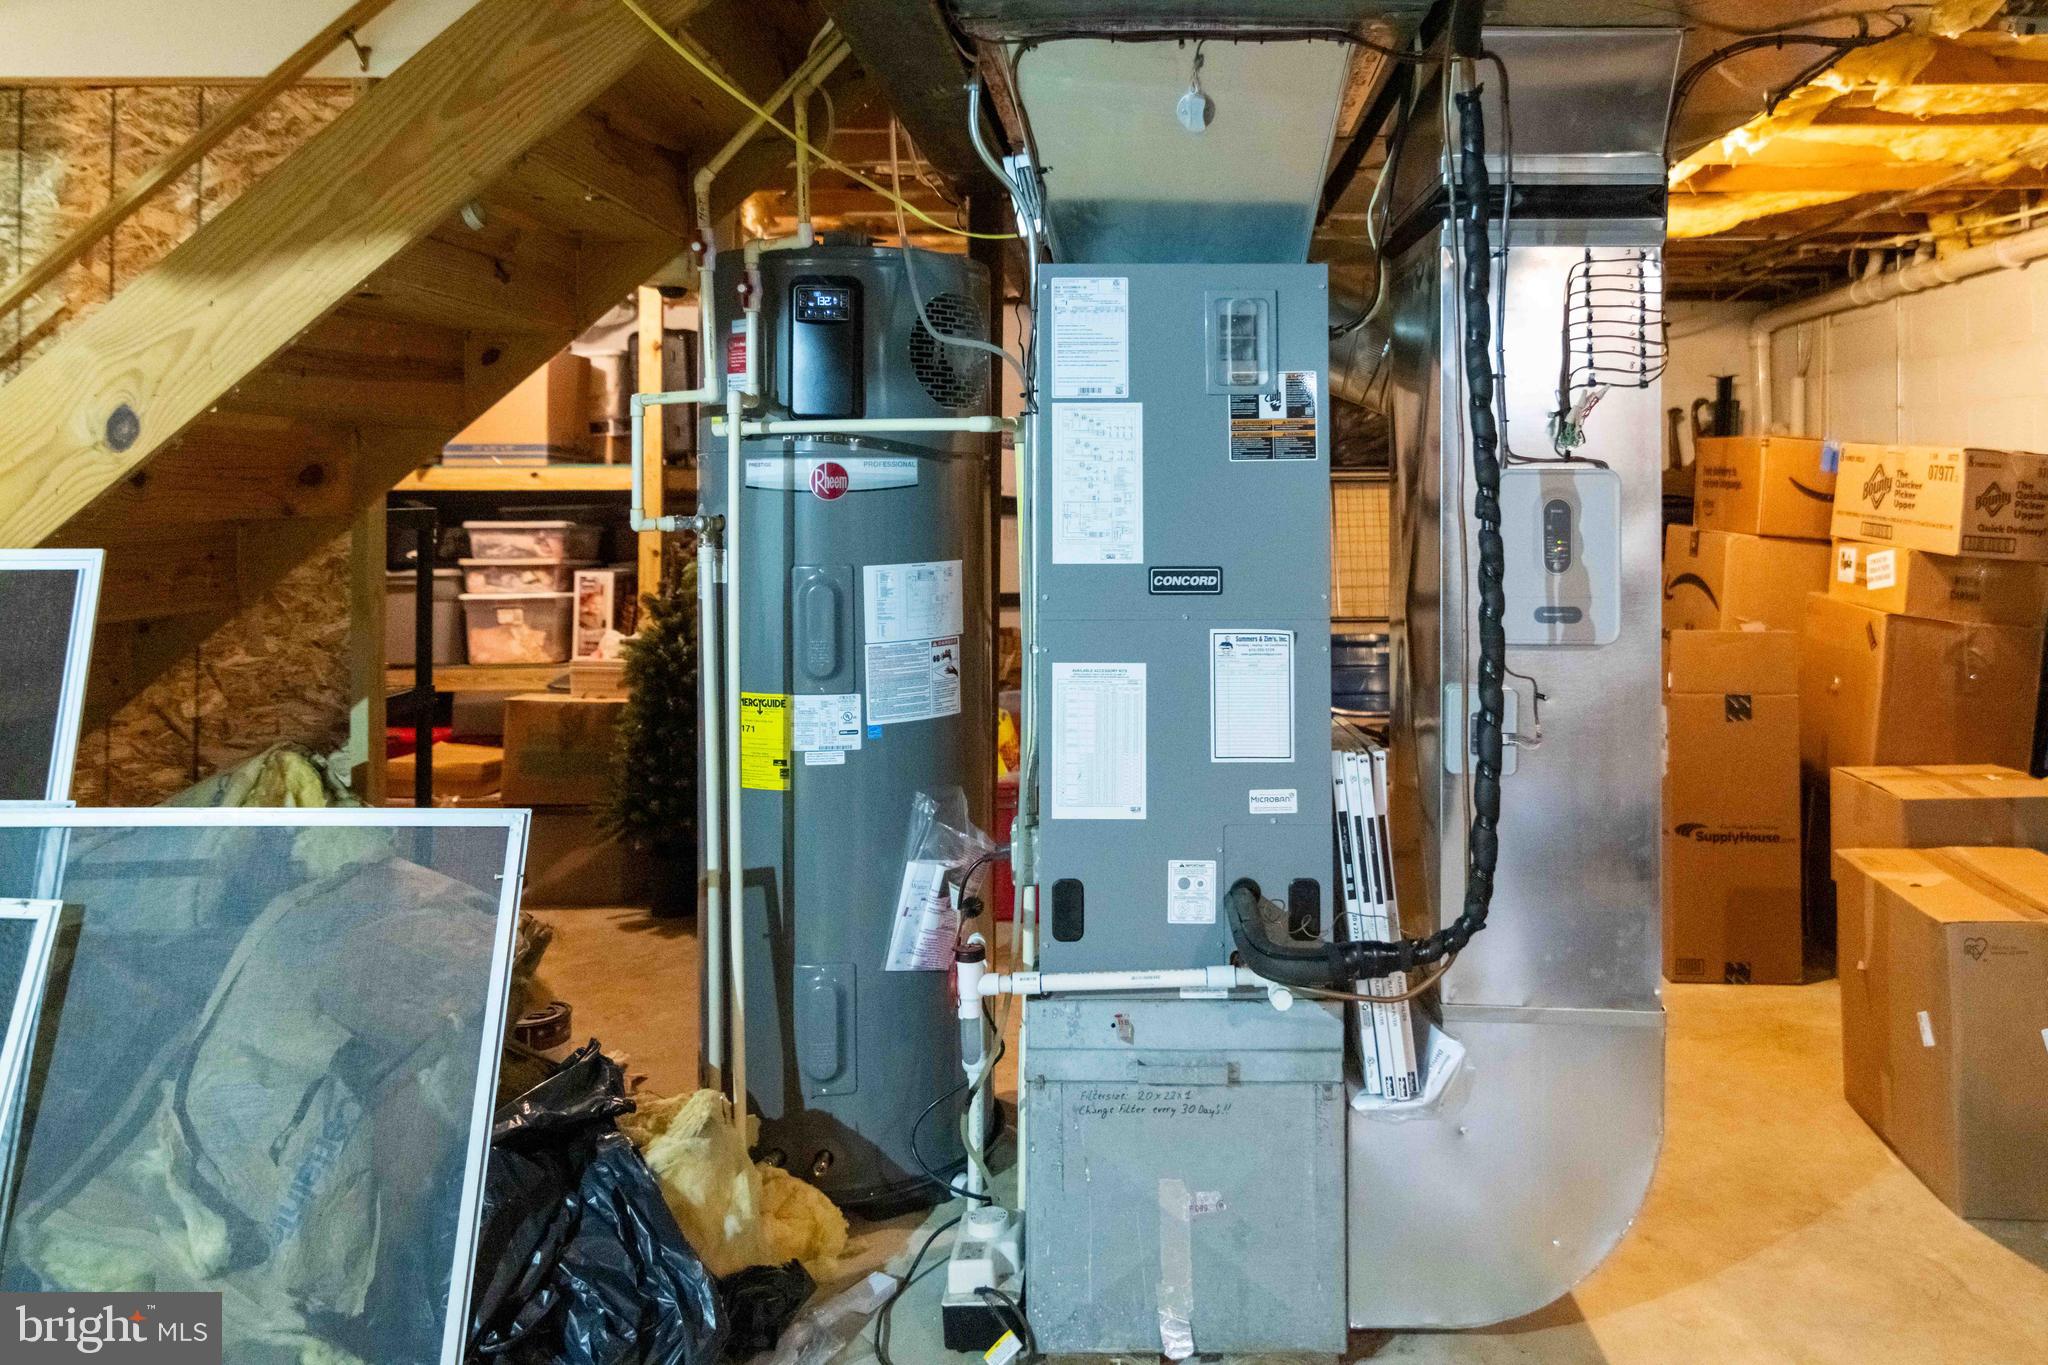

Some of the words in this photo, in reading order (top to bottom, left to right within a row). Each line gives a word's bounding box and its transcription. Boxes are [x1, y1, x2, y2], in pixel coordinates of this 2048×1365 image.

[814, 463, 848, 495] Rheem
[1896, 469, 1908, 478] The
[1928, 465, 1955, 482] 07977
[1862, 476, 1892, 501] Bounty
[1895, 480, 1922, 489] Quicker
[2017, 480, 2034, 489] The
[1894, 489, 1916, 499] Picker
[1894, 500, 1916, 511] Upper
[1975, 491, 2011, 511] Bounty
[2014, 510, 2045, 520] Upper
[1978, 523, 2004, 533] Quick
[1153, 575, 1218, 586] CONCORD
[1079, 1104, 1114, 1119] Change
[1152, 1106, 1177, 1118] every
[1181, 1103, 1195, 1114] 30
